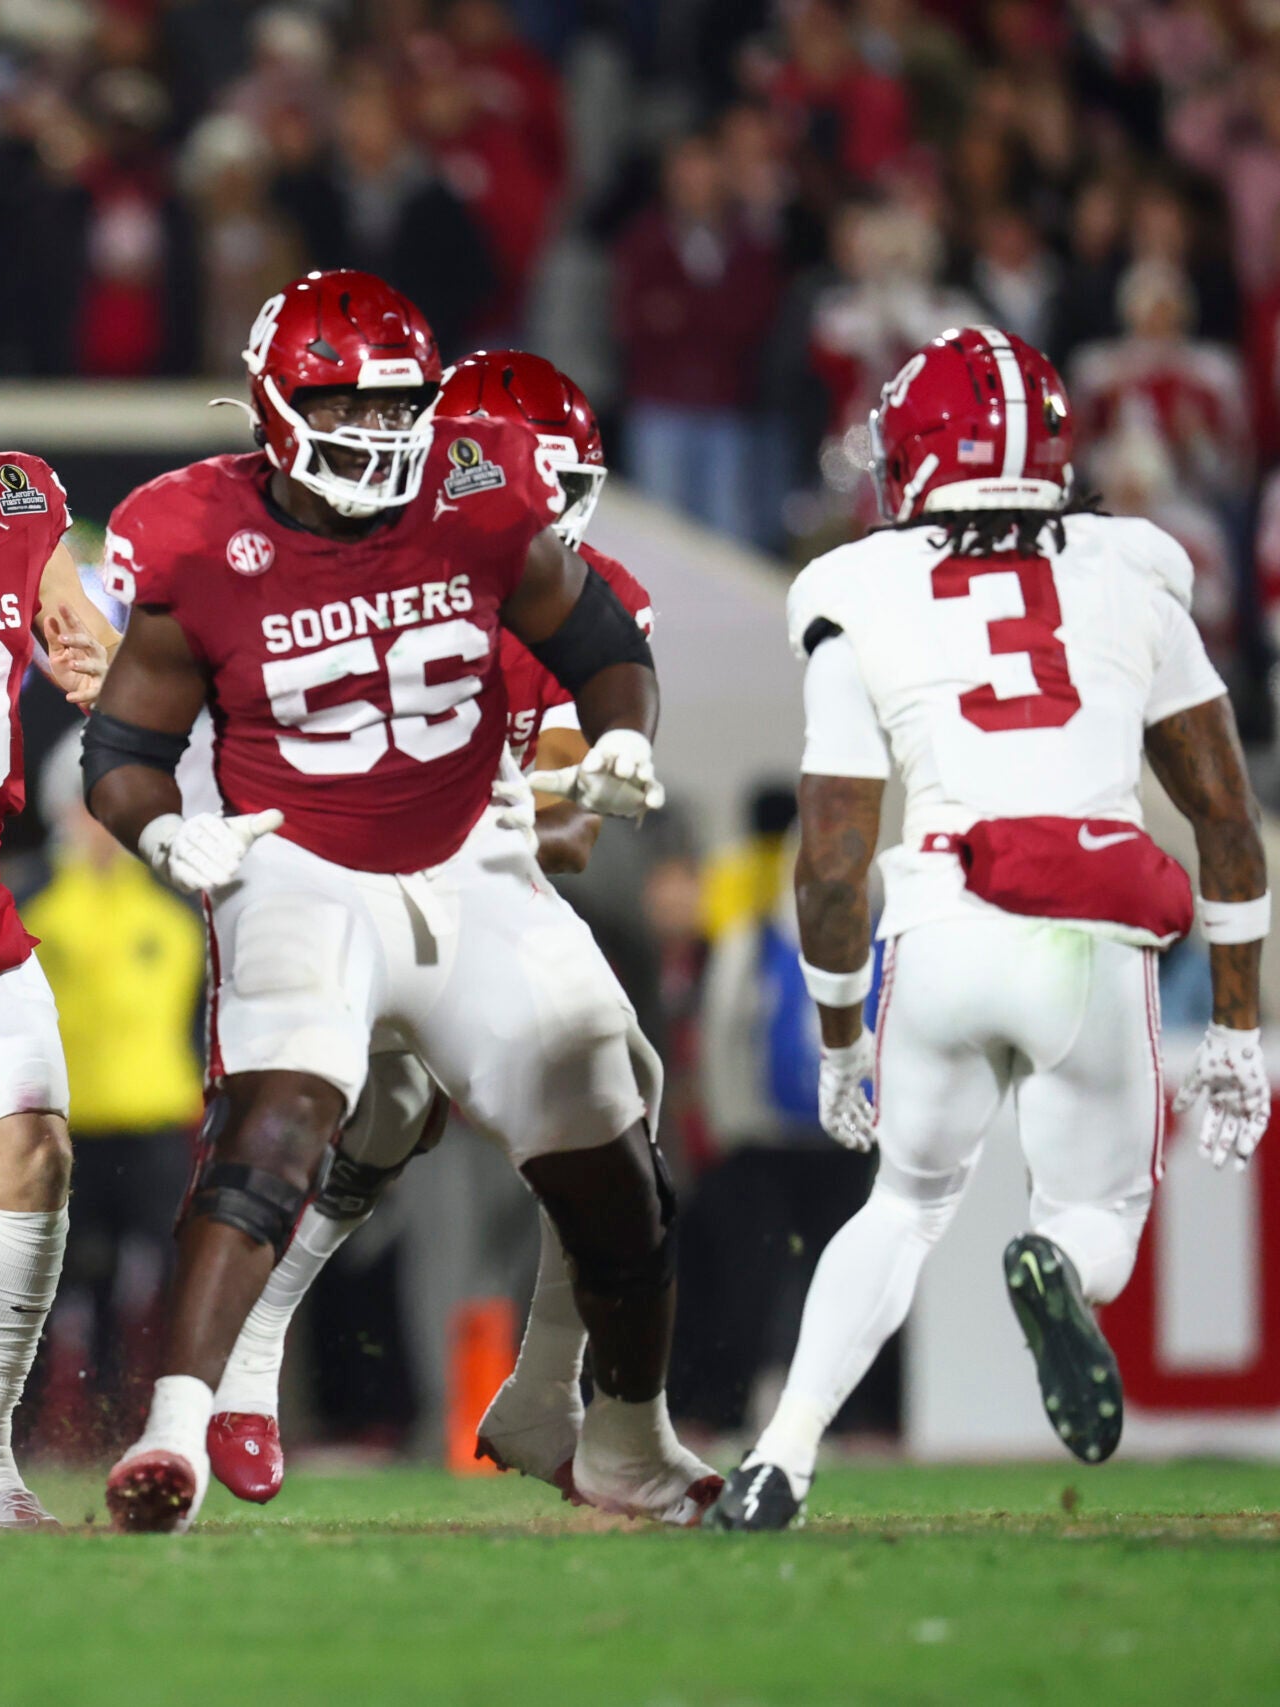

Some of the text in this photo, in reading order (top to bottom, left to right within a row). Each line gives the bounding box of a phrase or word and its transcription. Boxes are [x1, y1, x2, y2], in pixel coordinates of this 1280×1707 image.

[230, 532, 271, 572] SEC
[262, 573, 474, 654] SOONERS
[931, 550, 1082, 733] 3
[261, 618, 490, 775] 56
